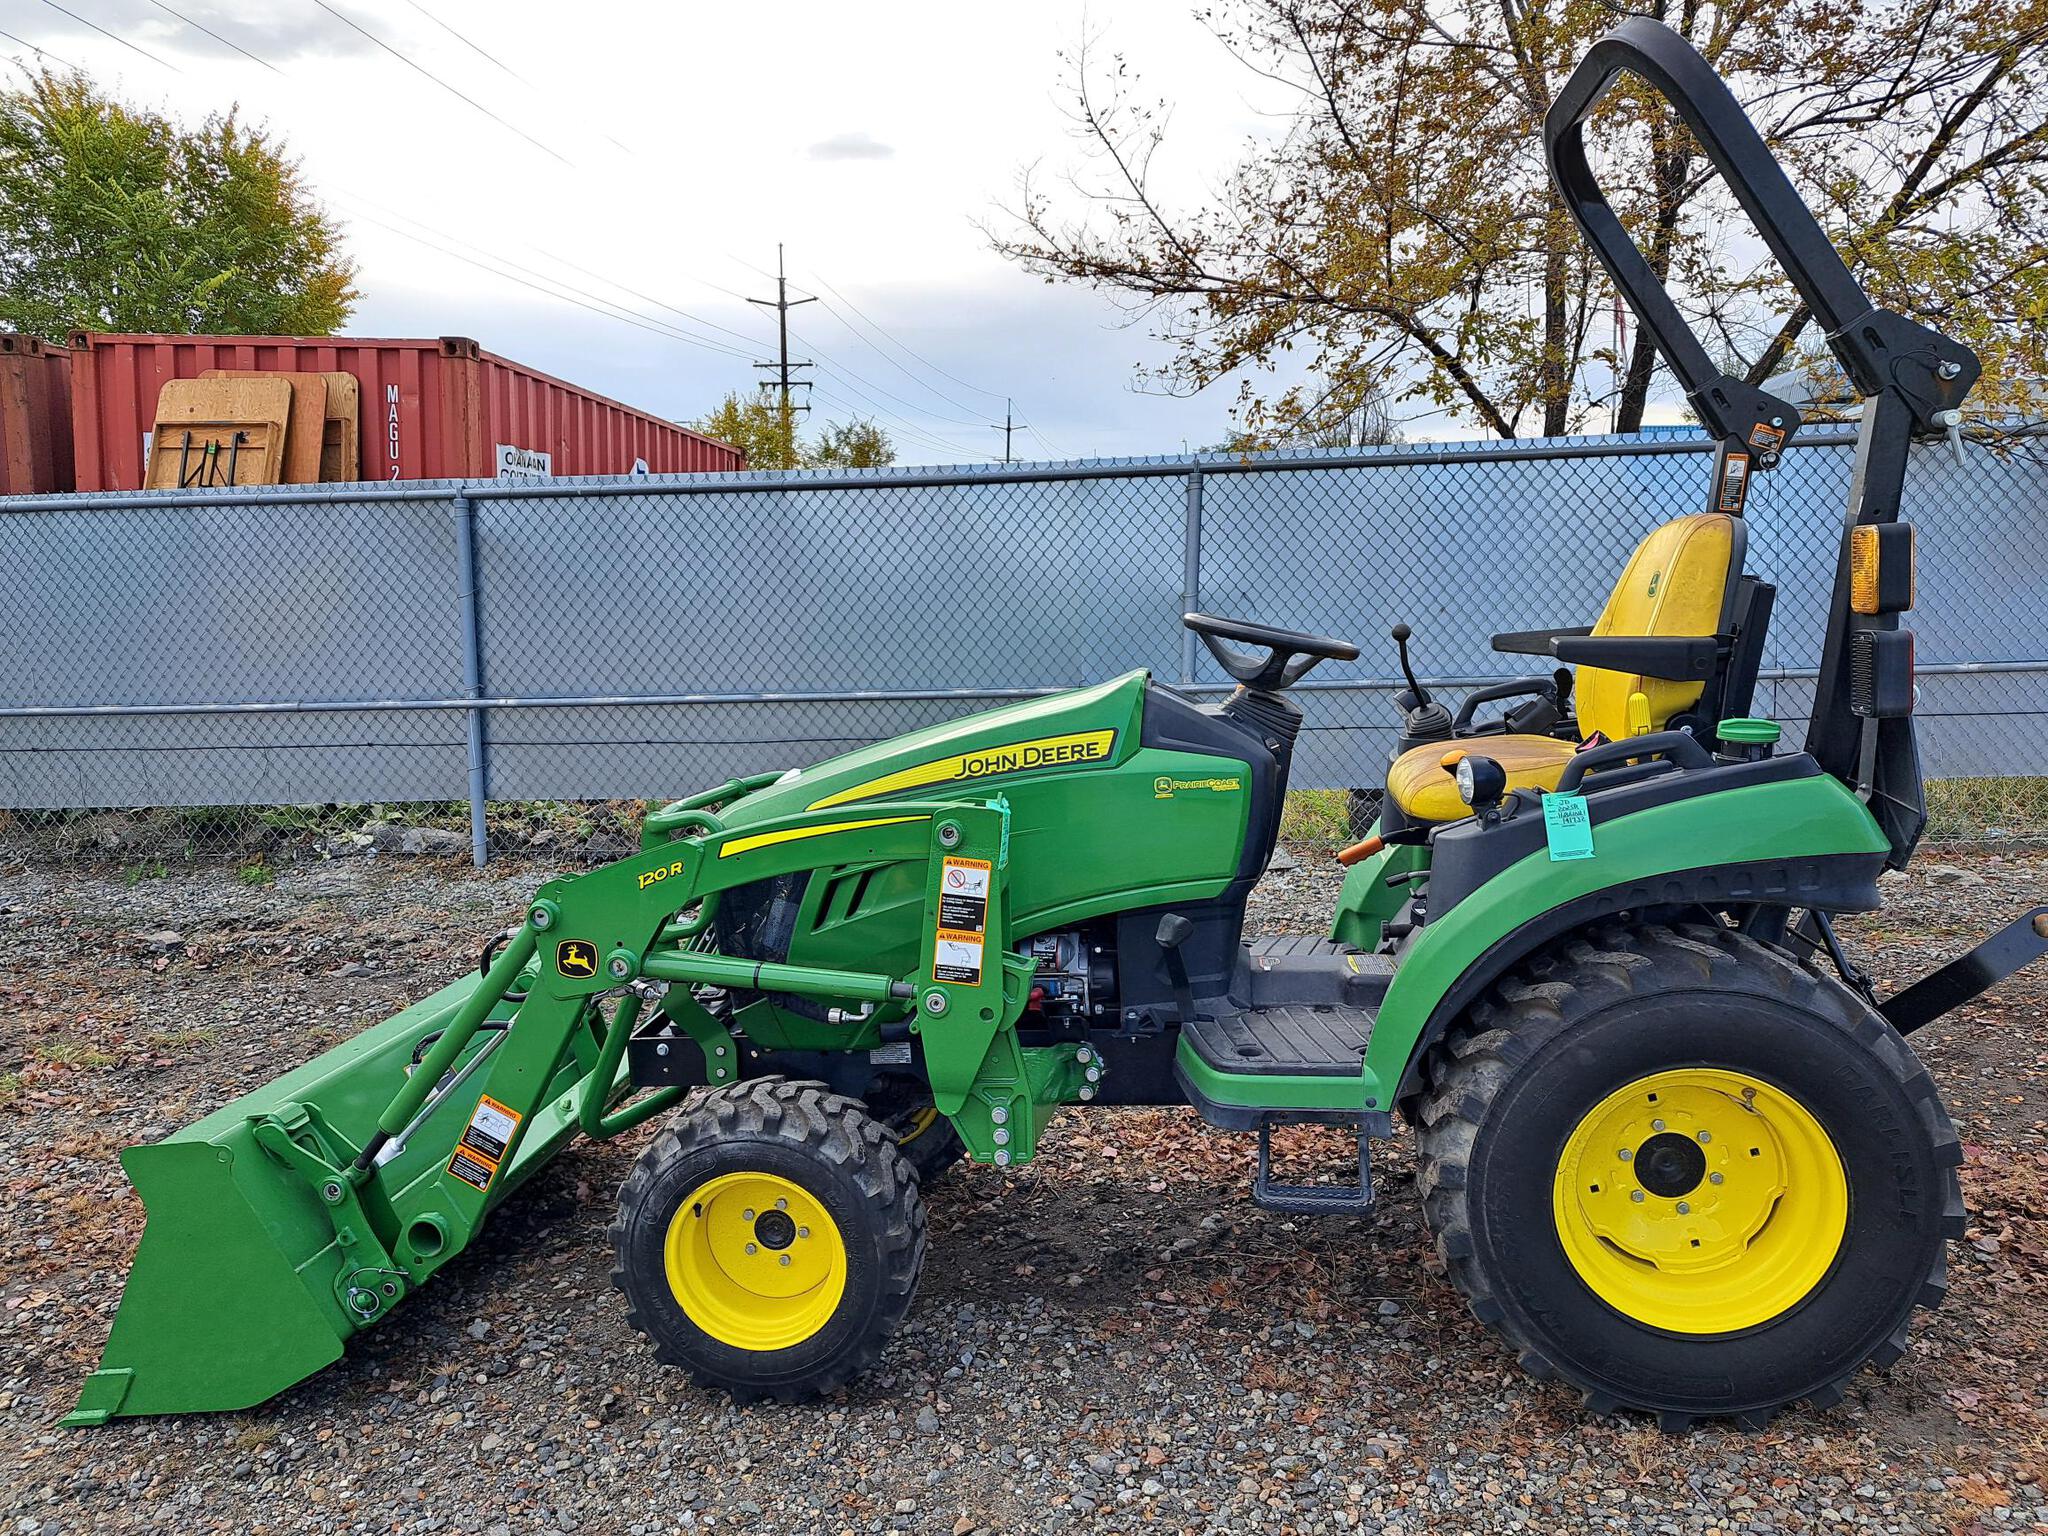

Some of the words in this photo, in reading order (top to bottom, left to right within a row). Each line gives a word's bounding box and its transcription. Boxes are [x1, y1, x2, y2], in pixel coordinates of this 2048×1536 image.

[387, 384, 399, 460] MAGU
[954, 752, 1017, 777] JOHN
[1023, 742, 1100, 766] DEERE
[953, 859, 989, 868] WARNING
[946, 933, 982, 943] WARNING
[490, 1101, 516, 1119] WARNING
[467, 1151, 493, 1170] WARNING
